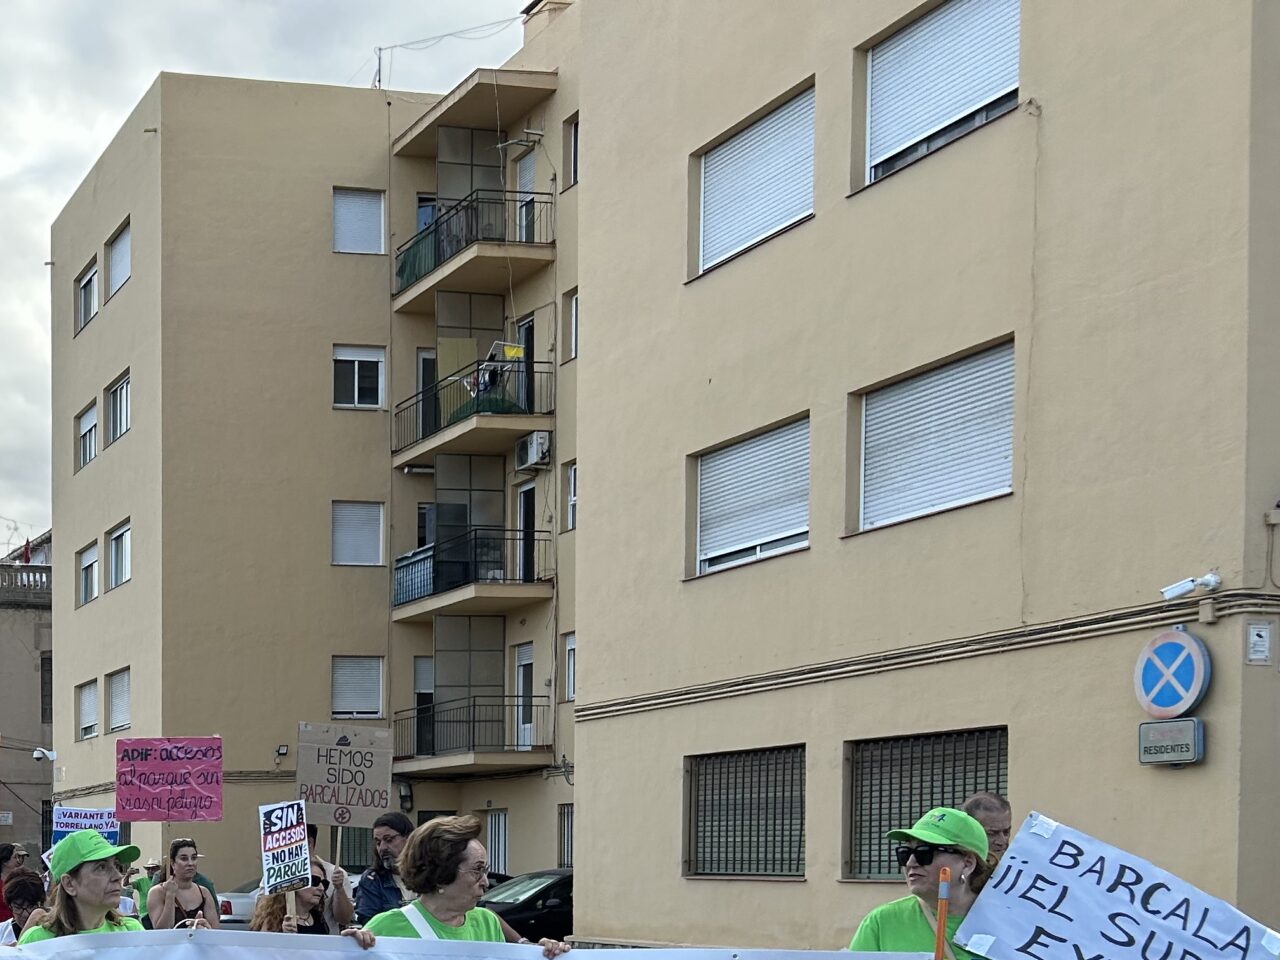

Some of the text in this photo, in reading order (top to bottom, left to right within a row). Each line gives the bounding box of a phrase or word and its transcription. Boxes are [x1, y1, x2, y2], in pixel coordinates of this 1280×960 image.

[159, 745, 223, 762] accesos
[316, 747, 374, 769] HEMOS
[1143, 743, 1191, 756] RESIDENTES
[118, 763, 220, 795] al parque sin
[326, 767, 366, 787] SIDO
[166, 788, 214, 820] peligro
[299, 783, 389, 809] BARCALIZADOS
[270, 804, 298, 832] SIN
[265, 824, 306, 851] ACCESOS
[271, 843, 304, 865] NO HAY
[266, 857, 310, 885] PARQUE
